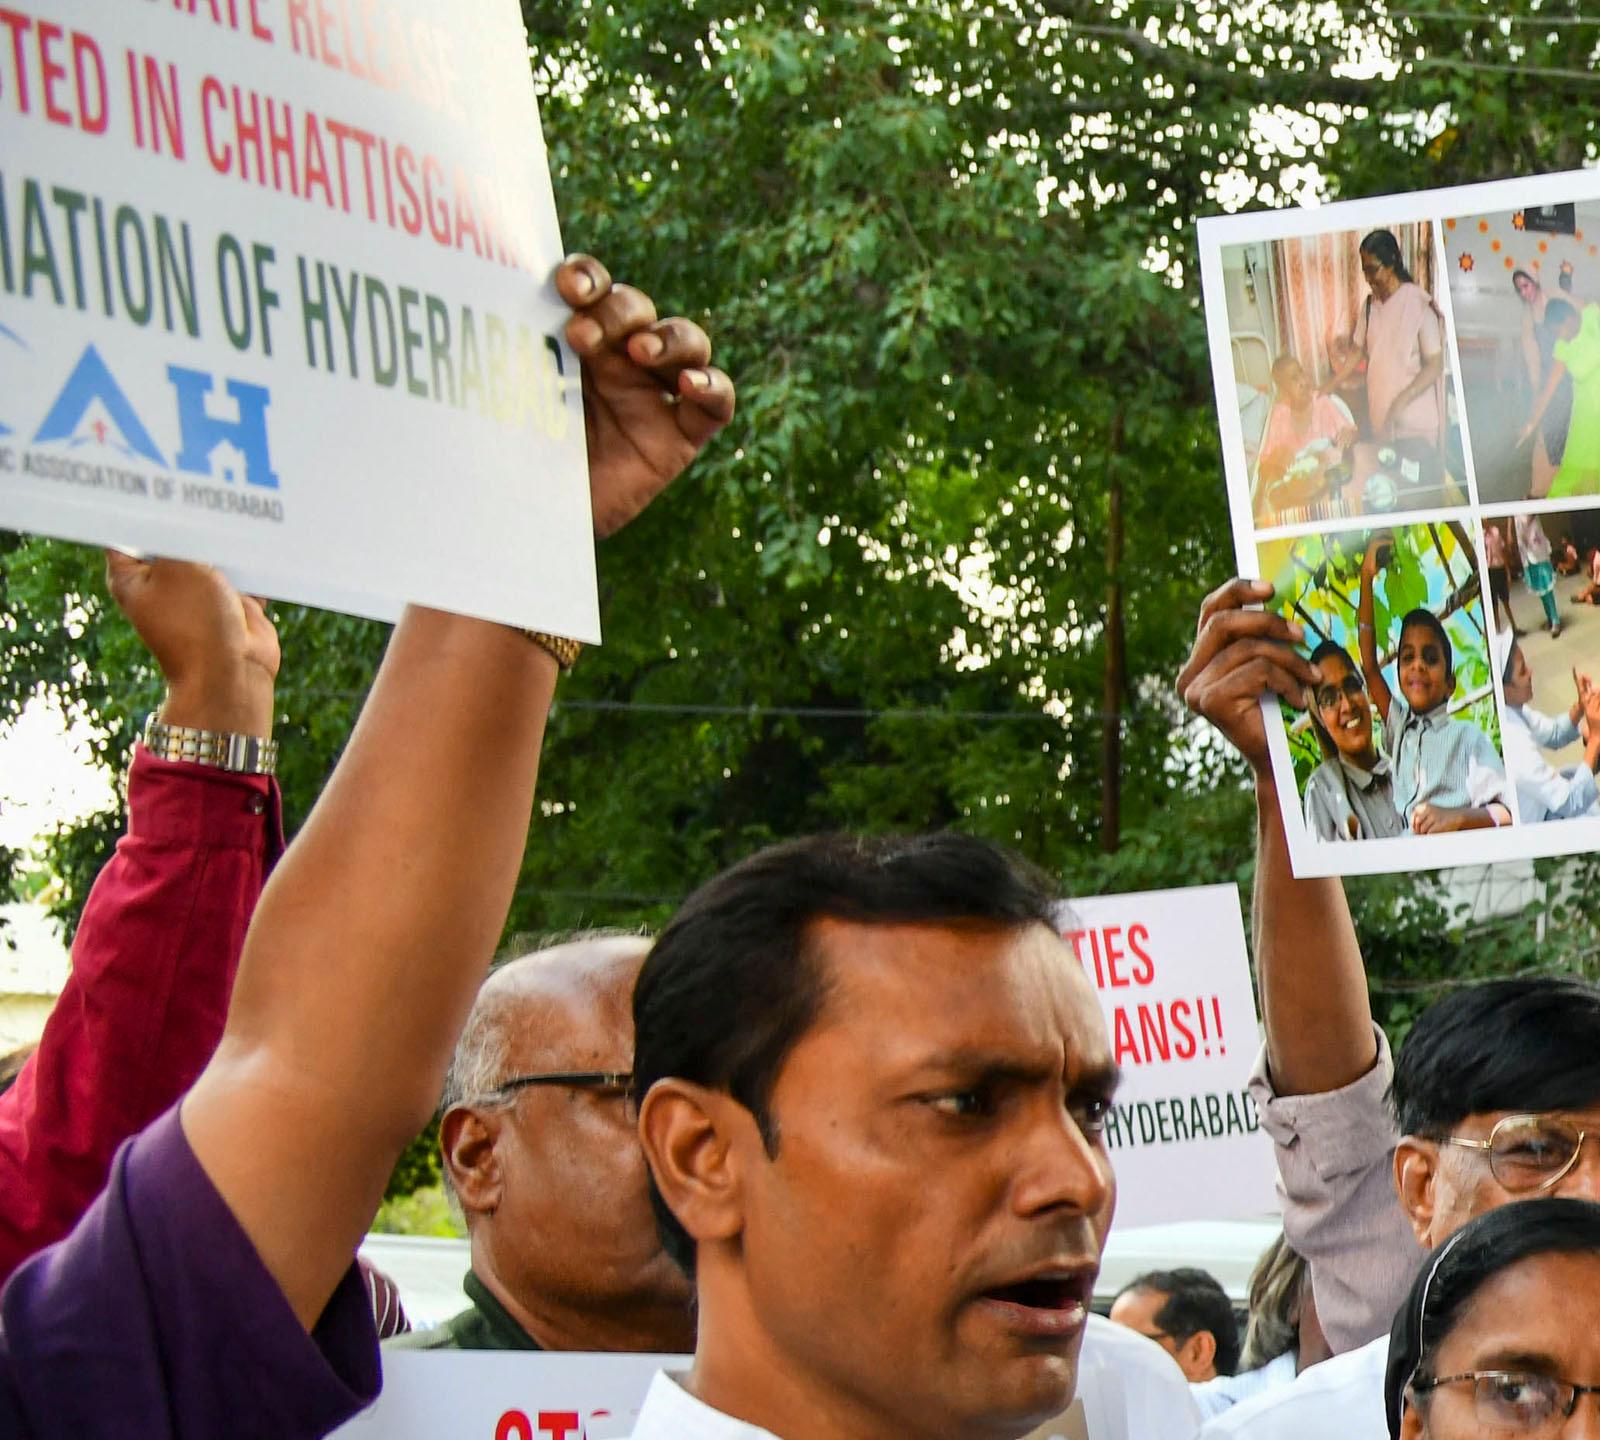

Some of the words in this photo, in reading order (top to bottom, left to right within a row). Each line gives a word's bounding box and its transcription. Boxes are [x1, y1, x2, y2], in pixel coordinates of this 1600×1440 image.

[0, 12, 110, 135] TED
[126, 48, 188, 162] IN
[0, 321, 281, 490] AH
[216, 231, 281, 357] OF
[297, 255, 567, 441] HYDERABAD
[23, 451, 148, 496] ASSOCIATION
[153, 476, 173, 500] OF
[180, 482, 285, 523] HYDERABAD
[1104, 1090, 1260, 1149] HYDERABAD
